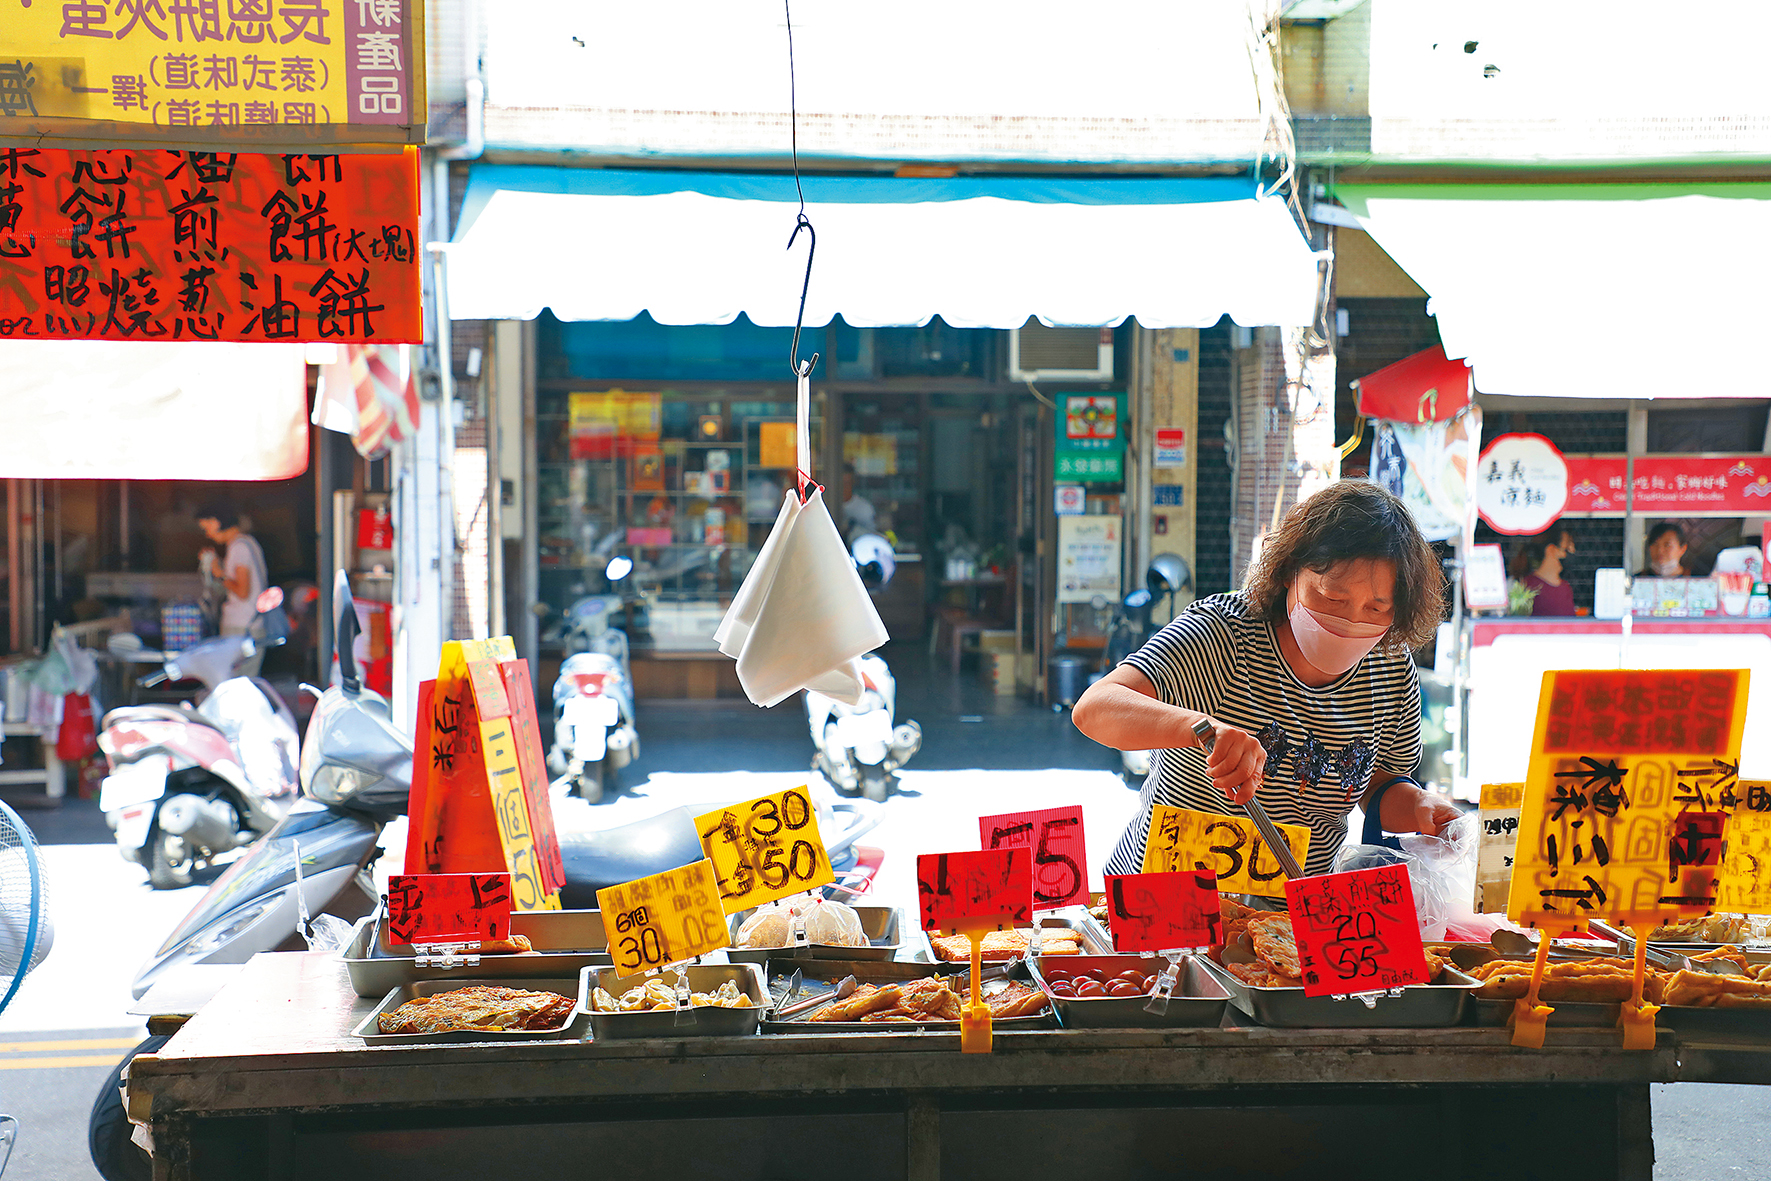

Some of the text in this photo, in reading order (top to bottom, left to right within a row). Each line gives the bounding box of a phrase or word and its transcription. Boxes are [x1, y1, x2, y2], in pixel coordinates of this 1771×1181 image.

[751, 790, 810, 836] 30
[762, 840, 816, 891] 50
[1194, 820, 1293, 882] 30
[616, 906, 649, 933] 6個
[1331, 911, 1376, 942] 20
[618, 927, 662, 969] 30
[1338, 945, 1378, 980] 55
